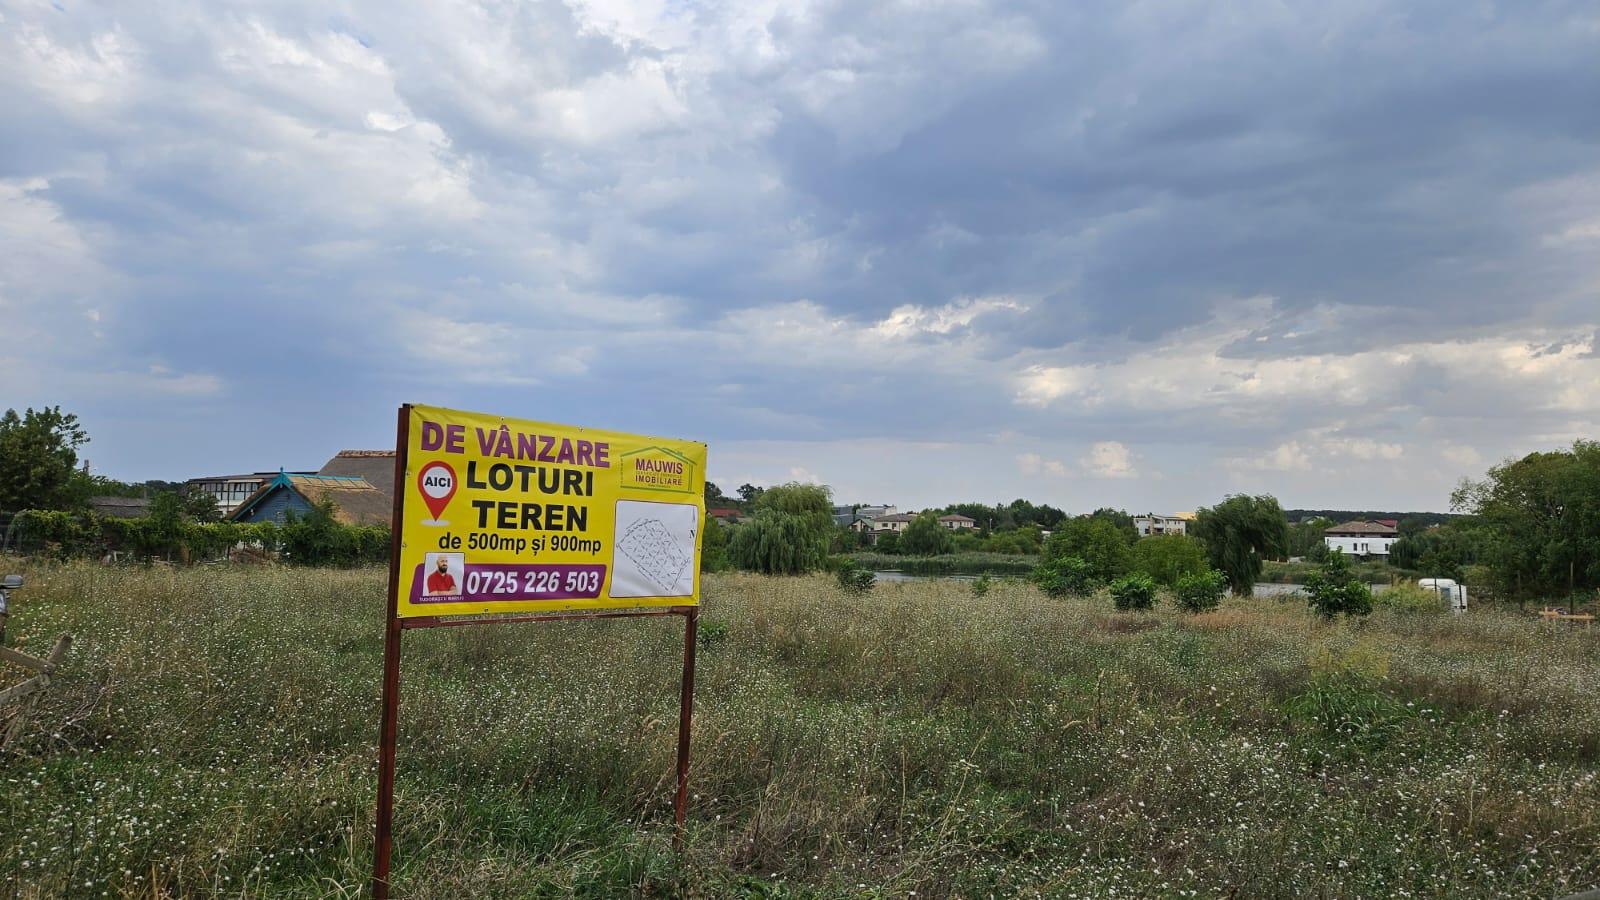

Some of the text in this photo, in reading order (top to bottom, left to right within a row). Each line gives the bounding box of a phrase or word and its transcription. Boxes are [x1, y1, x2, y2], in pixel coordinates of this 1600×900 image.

[421, 421, 611, 468] DE VÂNZARE
[467, 461, 593, 496] LOTURI
[635, 458, 683, 475] MAUWIS
[424, 476, 451, 488] AICI
[635, 475, 682, 486] IMOBILIARE
[472, 500, 587, 532] TEREN
[438, 532, 602, 556] de 500mp și 900mp
[466, 571, 599, 595] 0725 226 503
